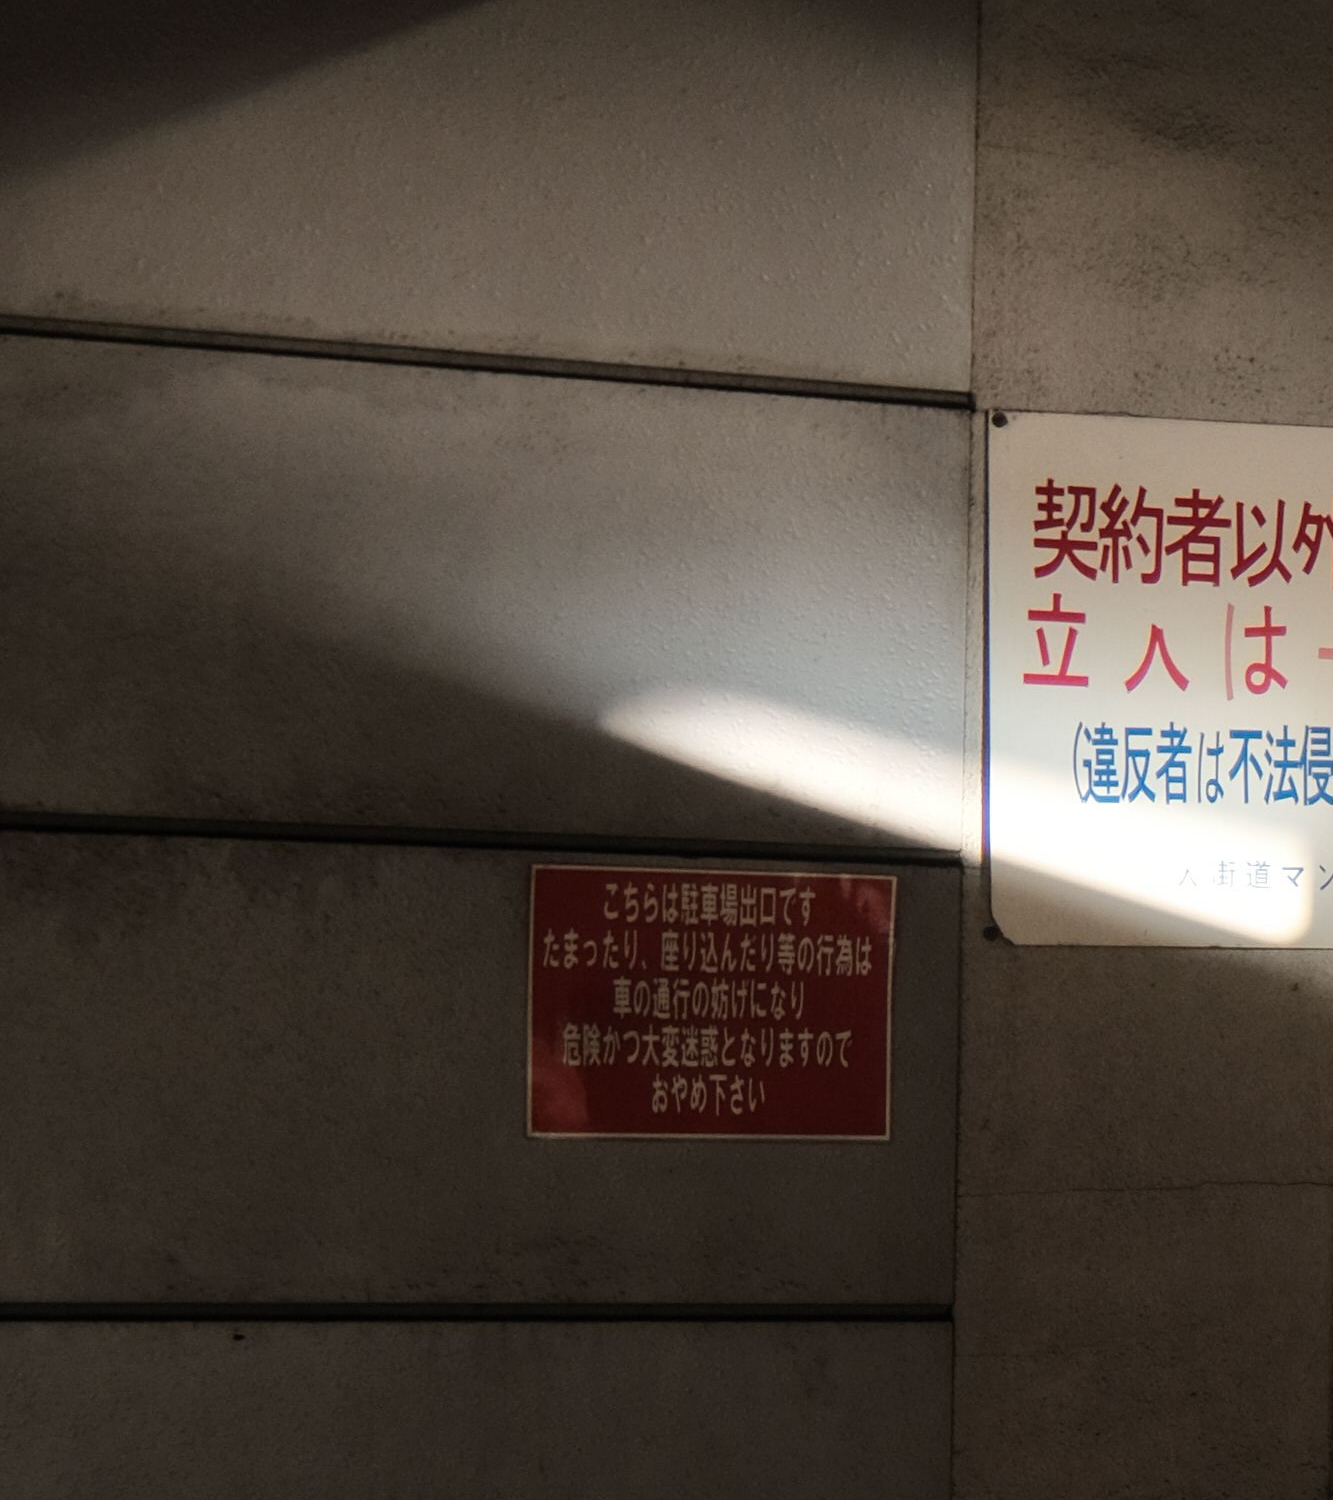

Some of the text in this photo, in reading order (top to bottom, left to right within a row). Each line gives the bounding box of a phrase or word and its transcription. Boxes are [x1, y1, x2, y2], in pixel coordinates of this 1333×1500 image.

[603, 883, 816, 926] こちらは駐車場出口です
[543, 929, 872, 974] たまったり、座り込んだり等の行為は
[613, 976, 804, 1020] 車の通行の妨げになり
[562, 1025, 852, 1069] 危険かつ大変迷惑となりますので
[652, 1074, 765, 1116] おやめ下さい
